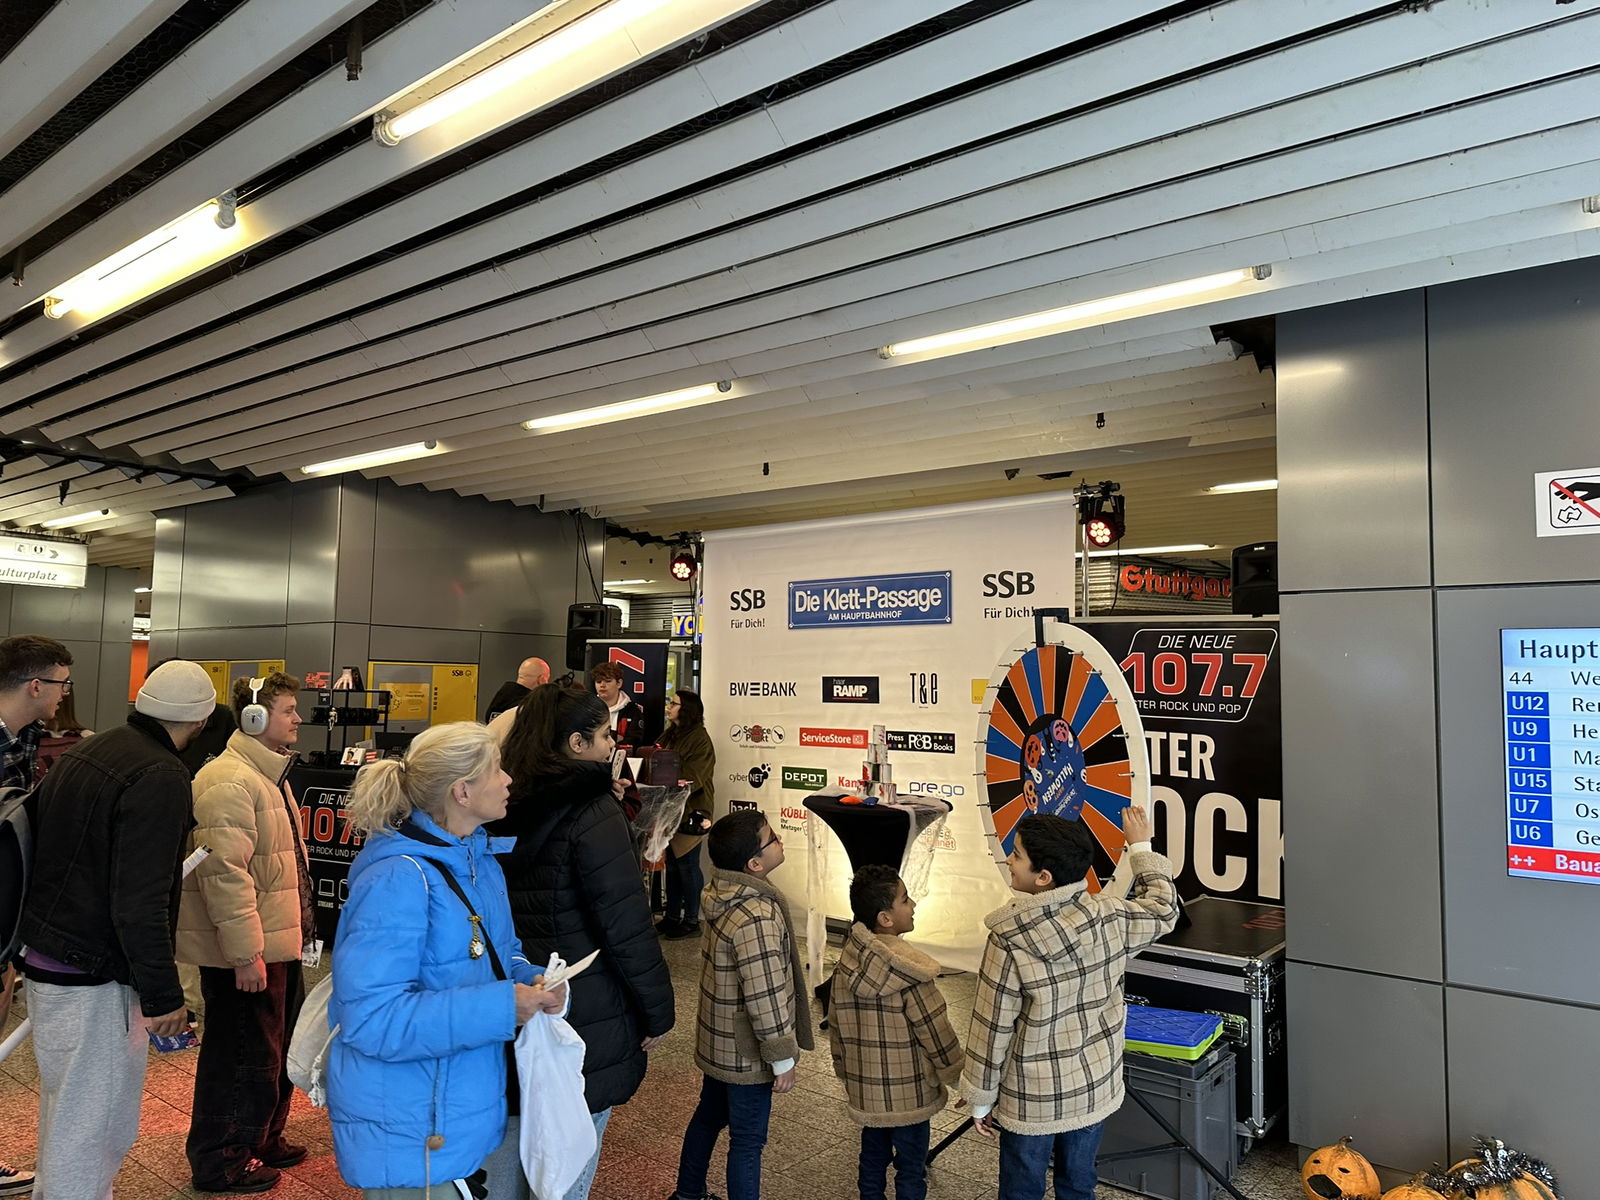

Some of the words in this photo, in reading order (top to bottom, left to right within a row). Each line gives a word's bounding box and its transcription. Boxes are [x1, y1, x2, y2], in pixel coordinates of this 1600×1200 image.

[983, 570, 1035, 598] SSB
[1121, 565, 1233, 600] Stuttgar
[730, 588, 766, 612] SSB
[795, 590, 820, 612] Die
[823, 586, 942, 612] Klett-Passage
[828, 612, 840, 621] AM
[841, 610, 903, 620] HAUPTBAHNHOF
[984, 607, 1002, 619] Für
[730, 619, 744, 629] Für
[745, 618, 765, 628] Dich!
[1157, 635, 1187, 649] DIE
[1189, 635, 1237, 649] NEUE
[1119, 652, 1268, 698] 107.7
[1509, 672, 1534, 685] 44
[833, 685, 868, 697] RAMP
[1159, 701, 1189, 711] ROCK
[1192, 702, 1216, 713] UND
[1218, 703, 1241, 714] POP
[1512, 695, 1544, 711] U12
[1572, 697, 1600, 712] Re
[1513, 721, 1538, 736] U9
[802, 733, 852, 744] ServiceStore
[887, 733, 904, 741] Press
[933, 743, 953, 751] Books
[1513, 747, 1536, 762] U1
[784, 772, 824, 783] DEPOT
[1514, 772, 1548, 788] U15
[909, 782, 964, 797] pre.go
[318, 793, 336, 805] DIE
[1515, 798, 1539, 814] U7
[1575, 803, 1600, 819] Os
[781, 824, 802, 832] Metzger
[1515, 824, 1541, 840] U6
[316, 846, 333, 855] ROCK
[335, 849, 349, 857] UND
